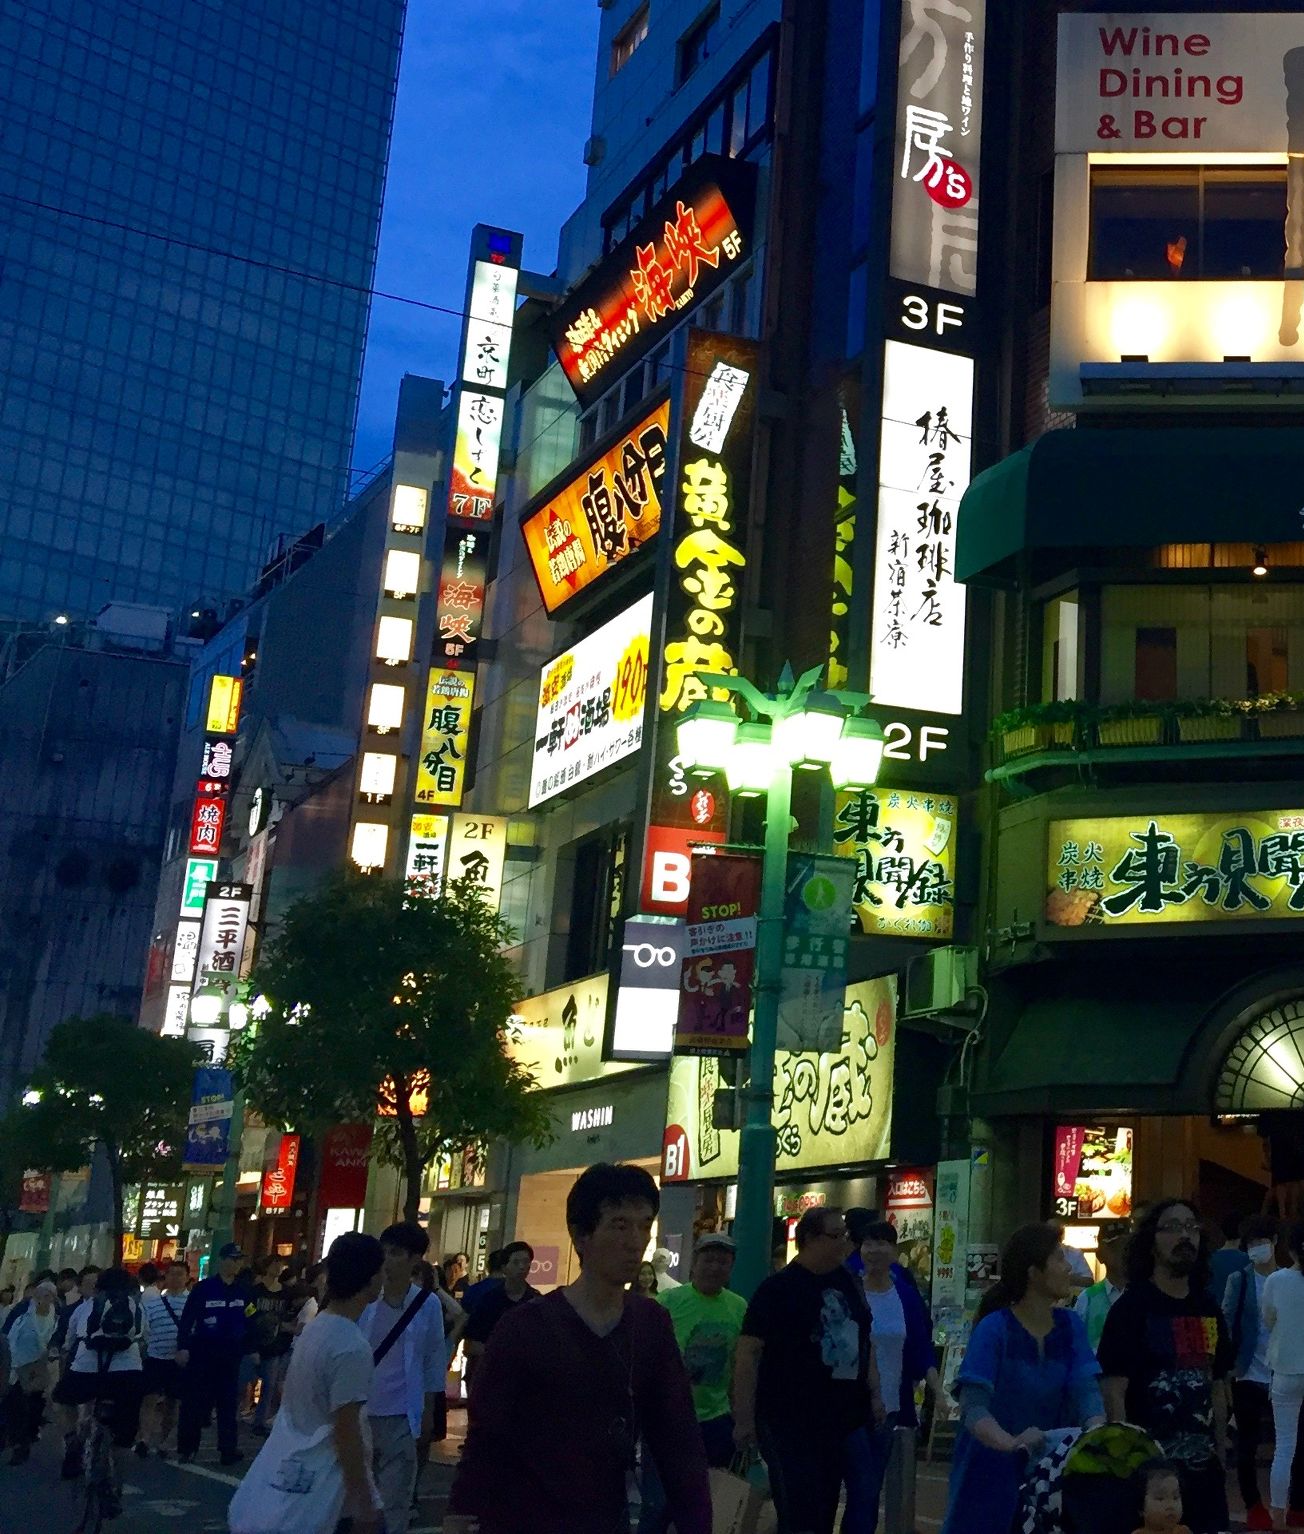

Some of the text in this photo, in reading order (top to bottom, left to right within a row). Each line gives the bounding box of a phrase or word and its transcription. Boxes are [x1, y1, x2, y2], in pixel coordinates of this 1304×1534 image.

[1098, 27, 1211, 57] Wine
[1099, 68, 1244, 105] Dining
[1096, 111, 1207, 139] & Bar
[721, 230, 742, 260] 5F
[630, 200, 720, 323] 海峡
[901, 295, 964, 335] 3F
[476, 336, 500, 385] 京町
[453, 493, 492, 518] 7F
[440, 581, 481, 643] 海峡
[423, 704, 465, 793] 腹八分目
[883, 722, 950, 762] 2F
[417, 790, 435, 801] 4F
[887, 793, 954, 815] 炭火串焼
[198, 804, 221, 845] 焼肉
[464, 822, 495, 840] 2F
[1058, 840, 1104, 865] 炭火
[219, 887, 242, 898] 2F
[1057, 866, 1104, 891] 串焼
[702, 902, 741, 919] STOP!
[571, 1105, 613, 1132] WASHIN
[665, 1135, 686, 1177] B1
[1056, 1197, 1078, 1216] 3F
